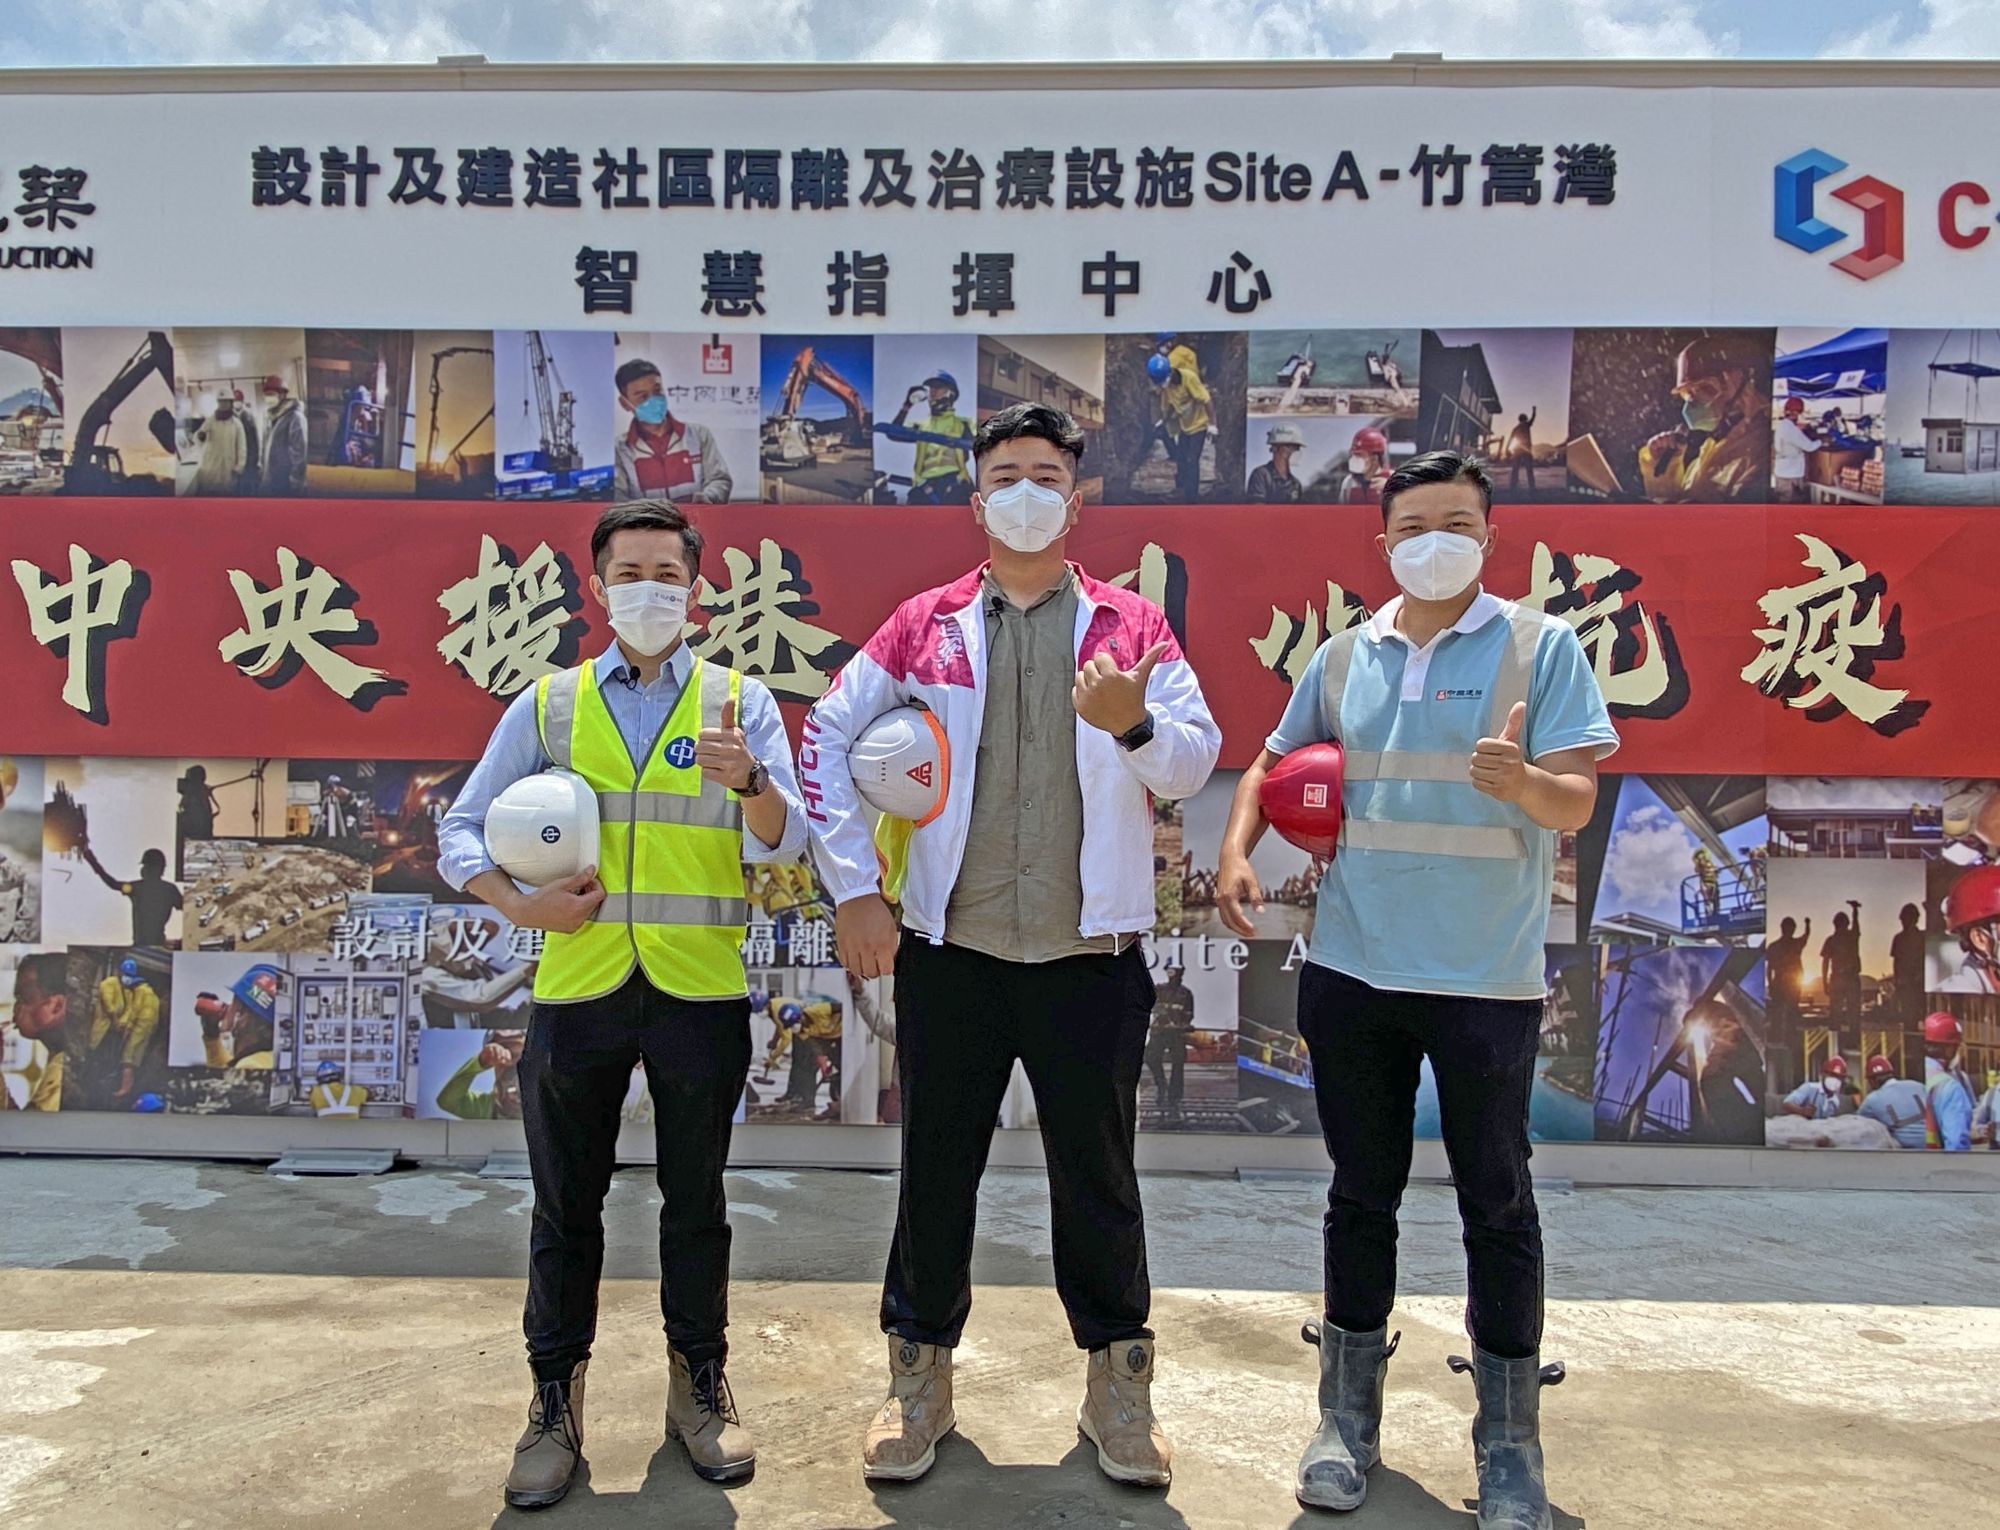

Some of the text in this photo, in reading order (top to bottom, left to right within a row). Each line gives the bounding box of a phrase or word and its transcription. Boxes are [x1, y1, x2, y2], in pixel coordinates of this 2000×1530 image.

[1938, 181, 2000, 251] C
[574, 245, 1273, 319] 智慧指揮中心
